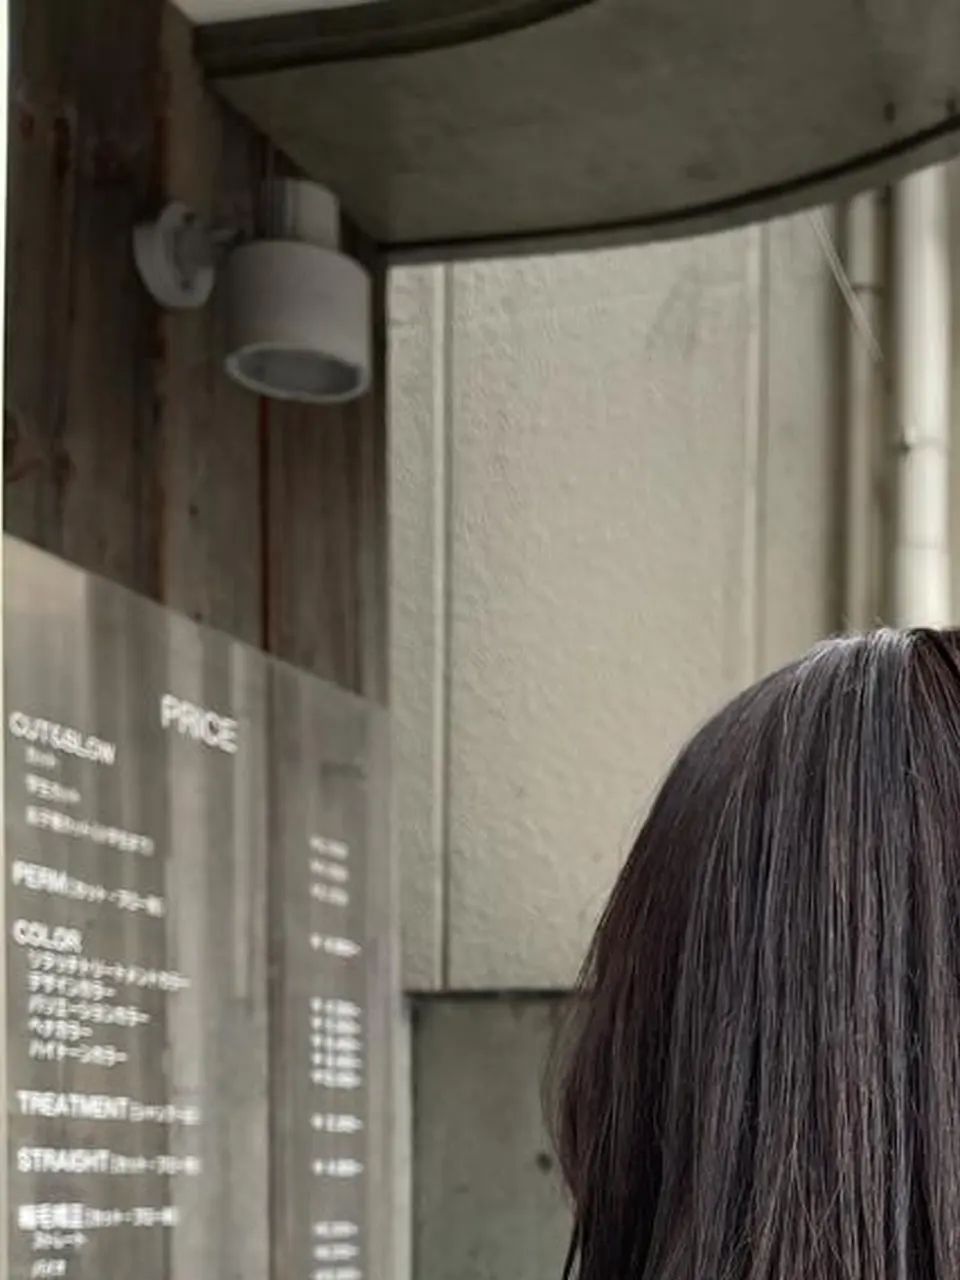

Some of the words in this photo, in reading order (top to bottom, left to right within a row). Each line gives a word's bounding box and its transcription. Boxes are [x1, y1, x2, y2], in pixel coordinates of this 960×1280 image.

[161, 693, 239, 754] PRICE
[13, 919, 82, 953] COLOR
[17, 1089, 130, 1120] TREATMENT
